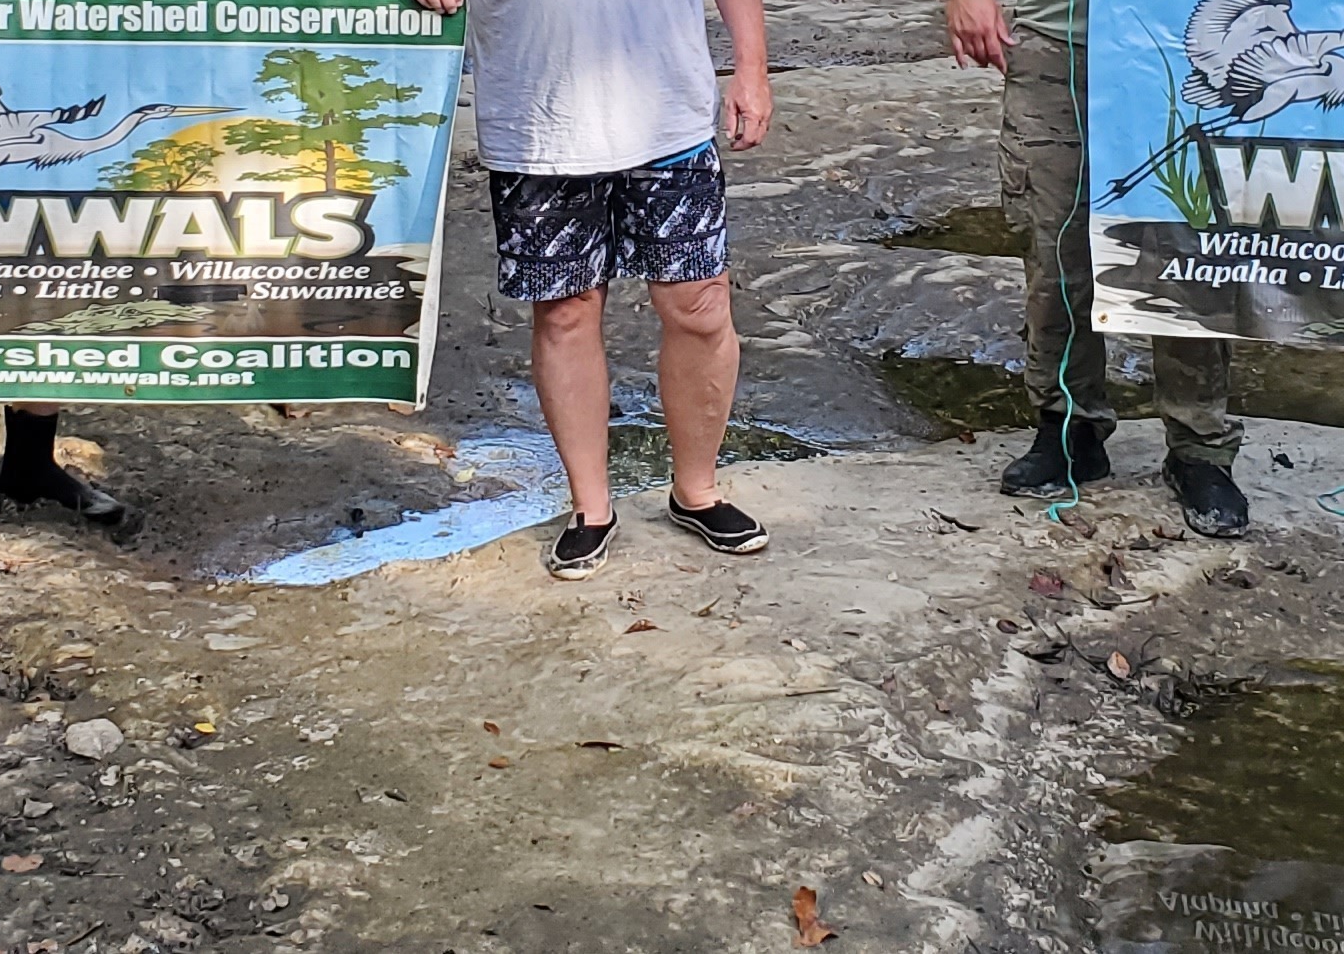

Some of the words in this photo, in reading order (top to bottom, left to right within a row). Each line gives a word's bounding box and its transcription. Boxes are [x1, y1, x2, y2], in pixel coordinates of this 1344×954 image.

[19, 0, 208, 33] Watershed
[215, 0, 442, 36] Conservation
[169, 260, 371, 281] Willacoochee
[1158, 257, 1287, 288] Alapaha
[35, 280, 119, 299] Little
[250, 281, 405, 301] Suwannee
[160, 343, 411, 369] Coalition
